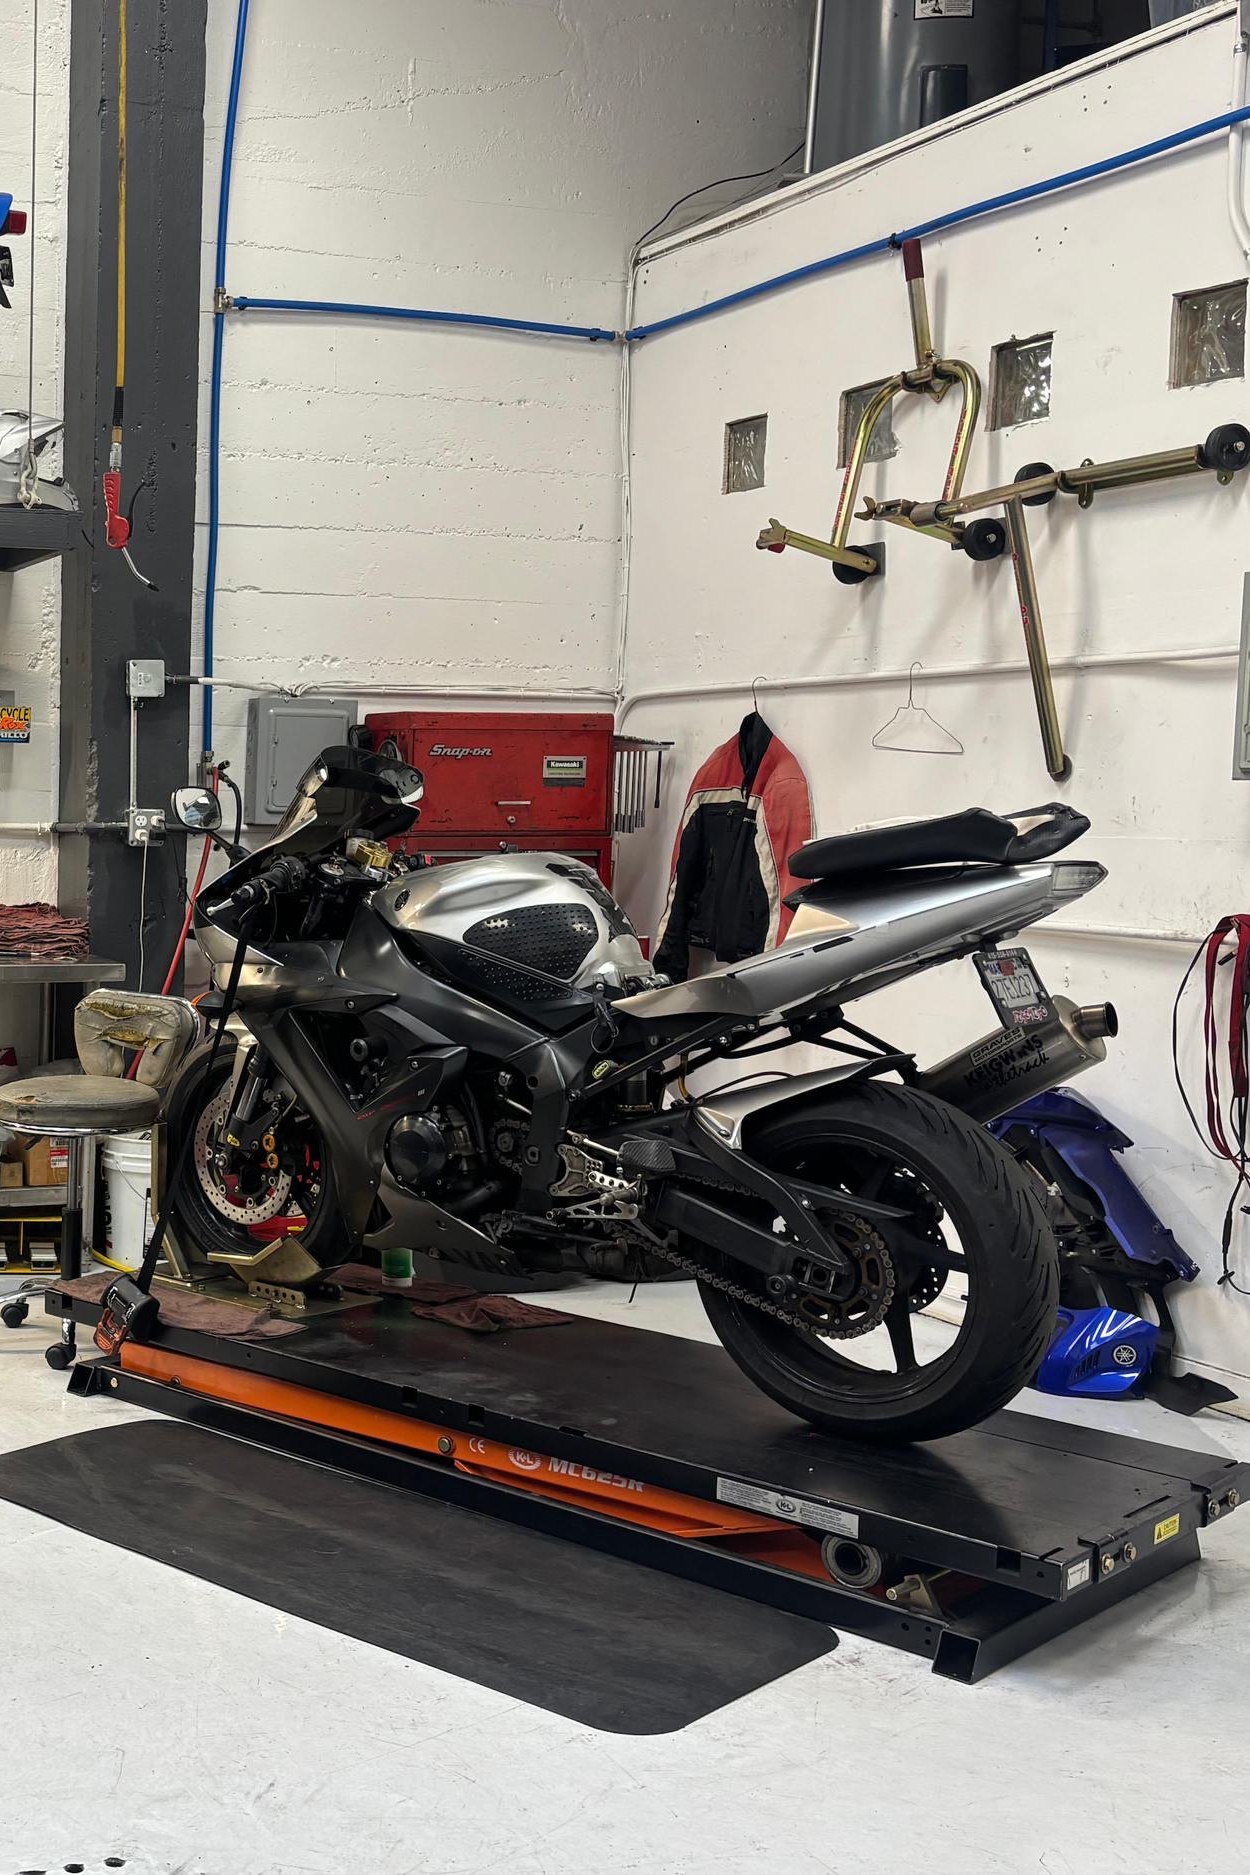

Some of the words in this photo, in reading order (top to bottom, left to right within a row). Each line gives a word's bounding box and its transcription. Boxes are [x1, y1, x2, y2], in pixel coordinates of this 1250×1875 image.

[429, 744, 493, 760] Snap-on
[550, 760, 581, 769] Kawasaki
[972, 1027, 1021, 1059] GRAVES
[974, 1033, 1023, 1063] MOTORSPORTS
